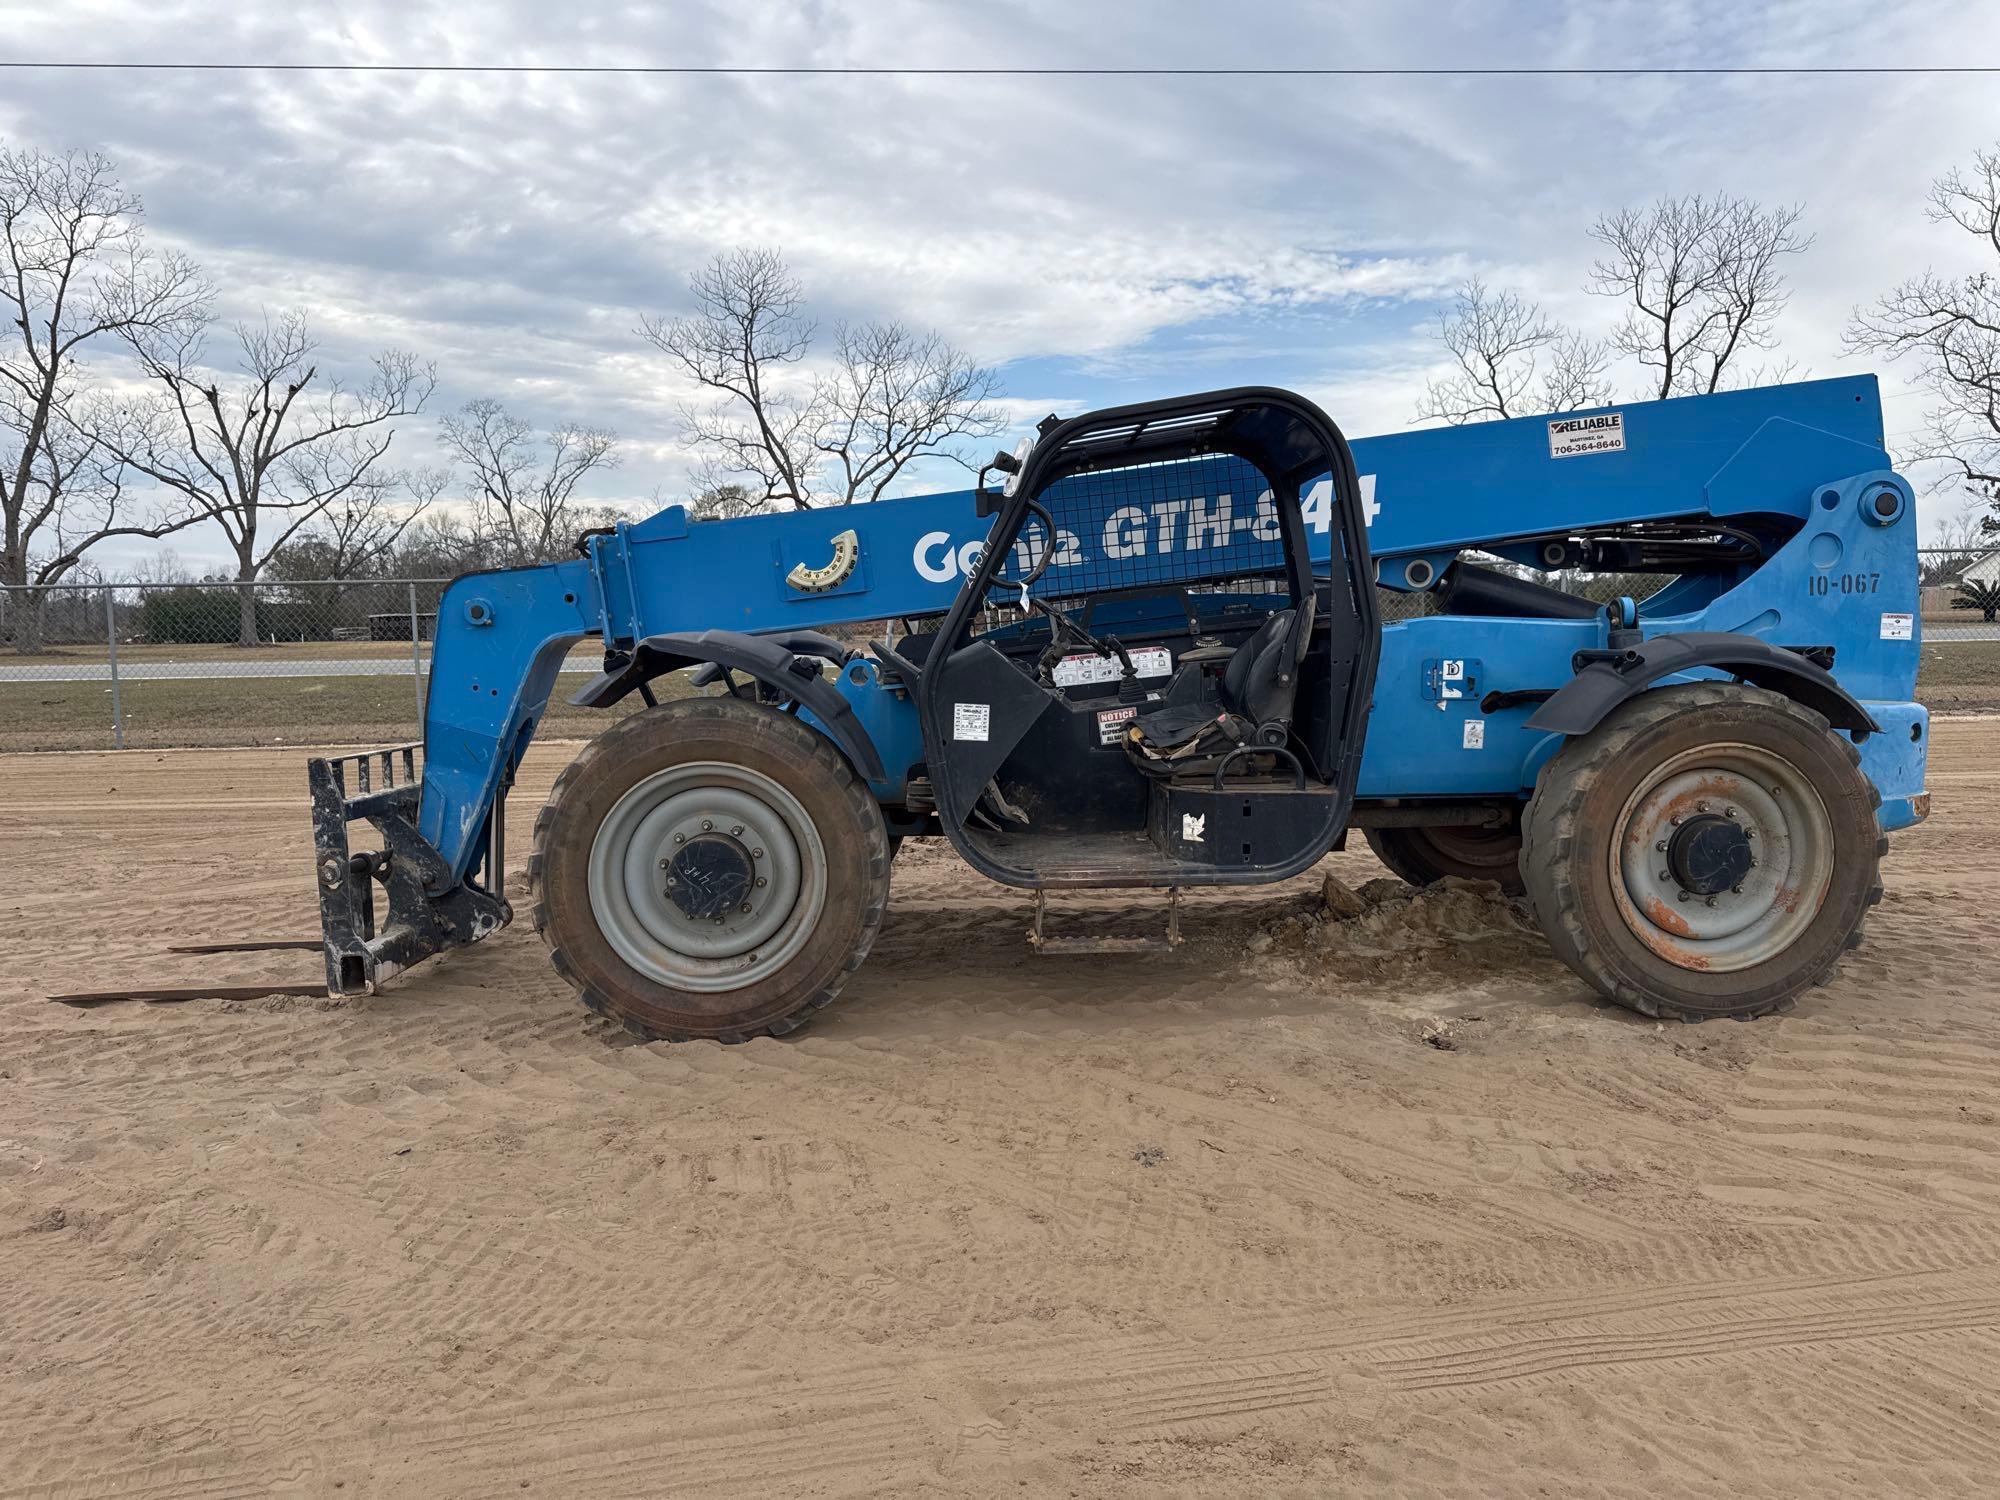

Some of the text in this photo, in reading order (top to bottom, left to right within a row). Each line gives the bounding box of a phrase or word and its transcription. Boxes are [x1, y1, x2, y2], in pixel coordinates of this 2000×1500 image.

[1561, 416, 1619, 432] RELIABLE
[1554, 440, 1621, 454] 706-364-8640
[1102, 474, 1381, 560] GTH-844
[1809, 573, 1880, 596] 10-067
[1101, 710, 1133, 722] NOTICE
